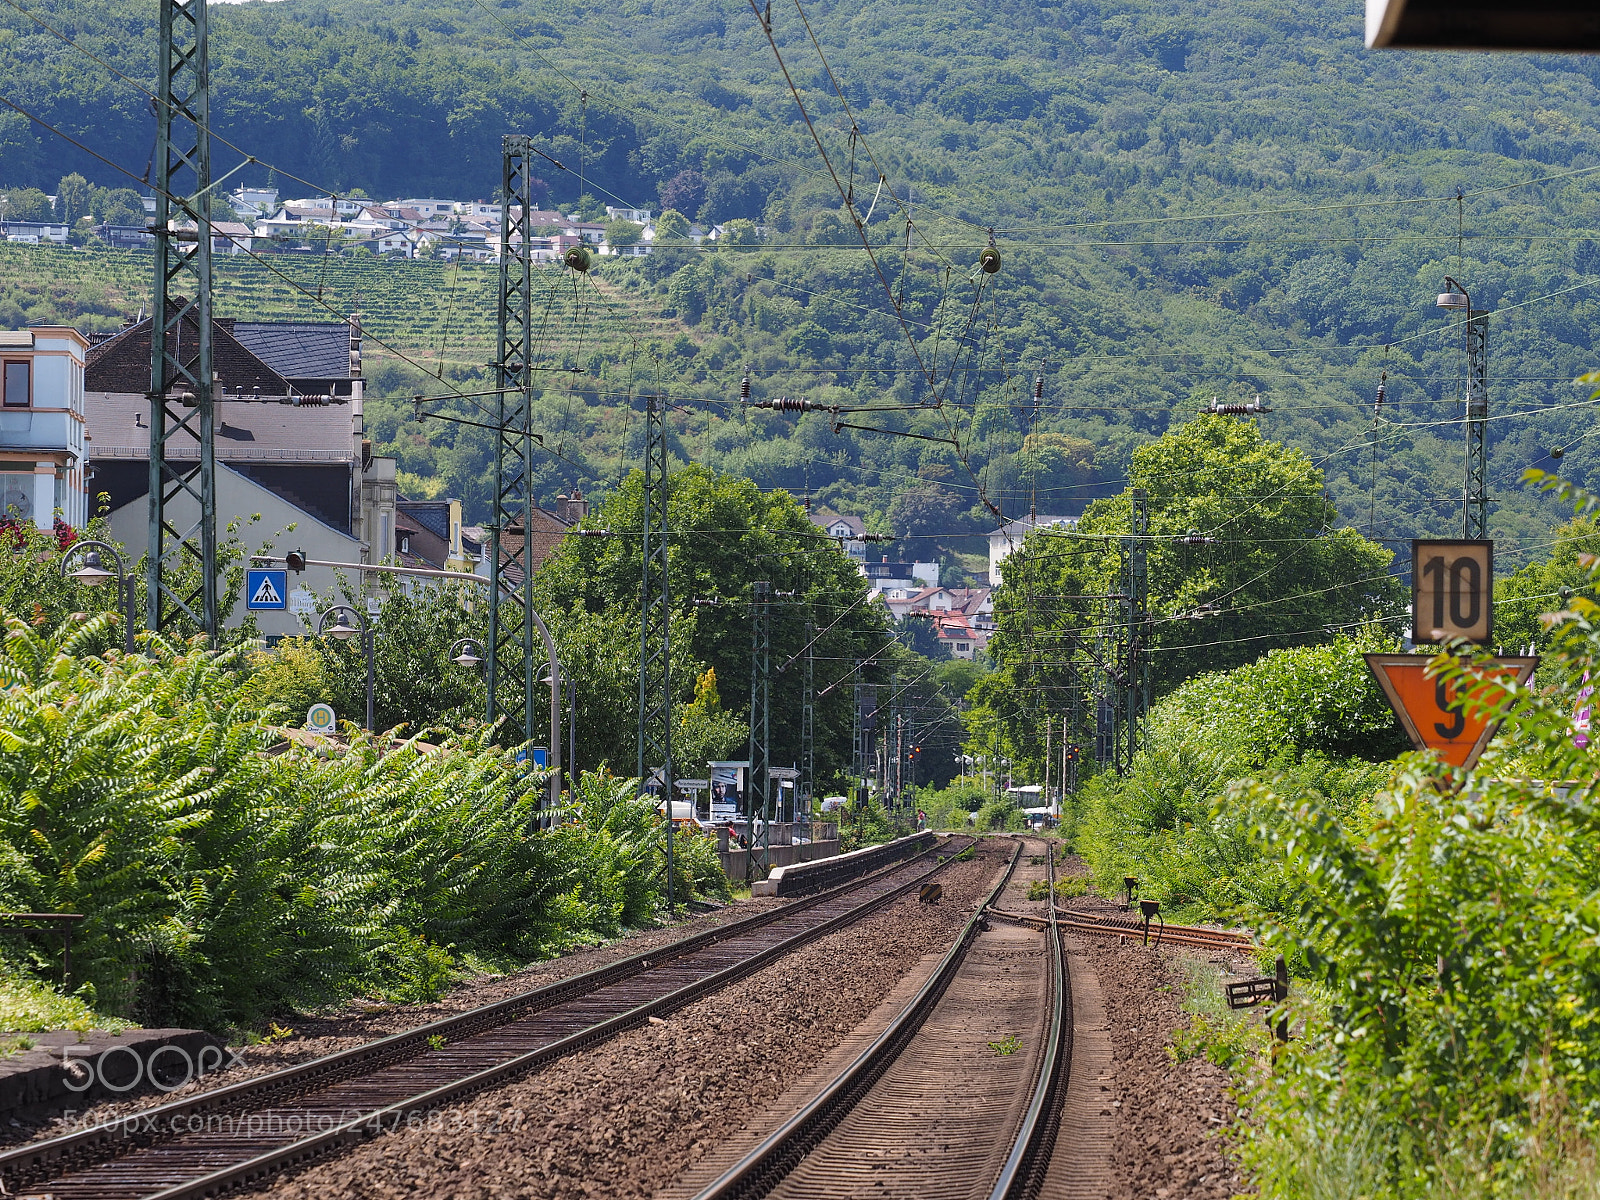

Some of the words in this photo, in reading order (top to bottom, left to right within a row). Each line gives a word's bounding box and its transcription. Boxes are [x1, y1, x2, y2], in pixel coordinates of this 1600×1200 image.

[1423, 556, 1481, 629] 10
[316, 711, 326, 724] H
[1434, 669, 1466, 739] 9
